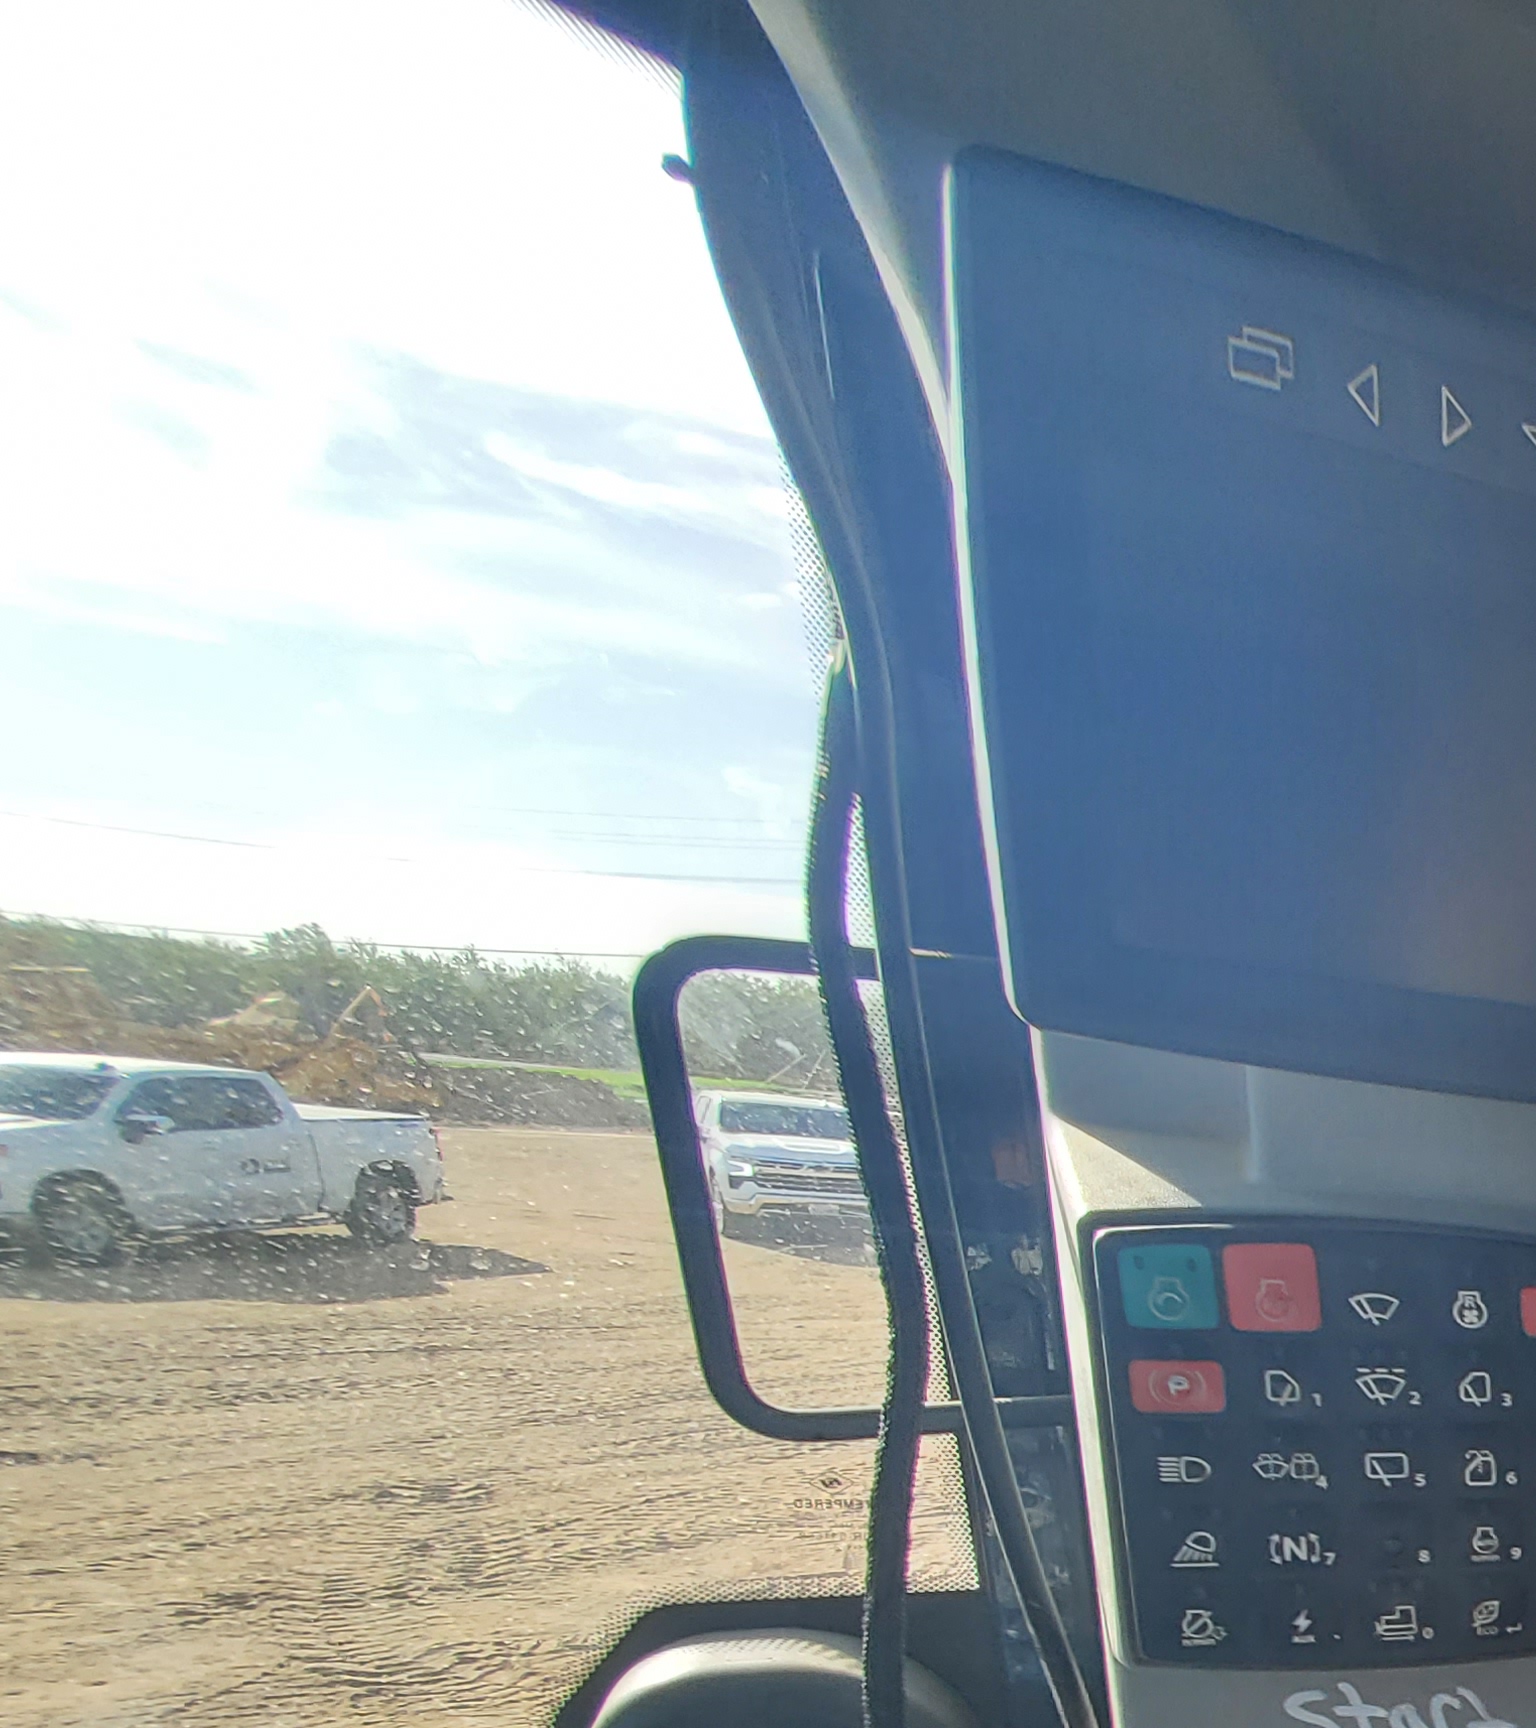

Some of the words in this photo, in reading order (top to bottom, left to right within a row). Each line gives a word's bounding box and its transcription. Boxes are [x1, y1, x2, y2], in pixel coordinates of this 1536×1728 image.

[1310, 1392, 1323, 1408] 1
[1408, 1390, 1422, 1406] 2
[1500, 1392, 1513, 1408] 3
[1314, 1474, 1329, 1490] 4
[1413, 1473, 1427, 1488] 5
[1504, 1471, 1518, 1486] 6
[1322, 1551, 1337, 1566] 7
[1509, 1546, 1523, 1561] 9
